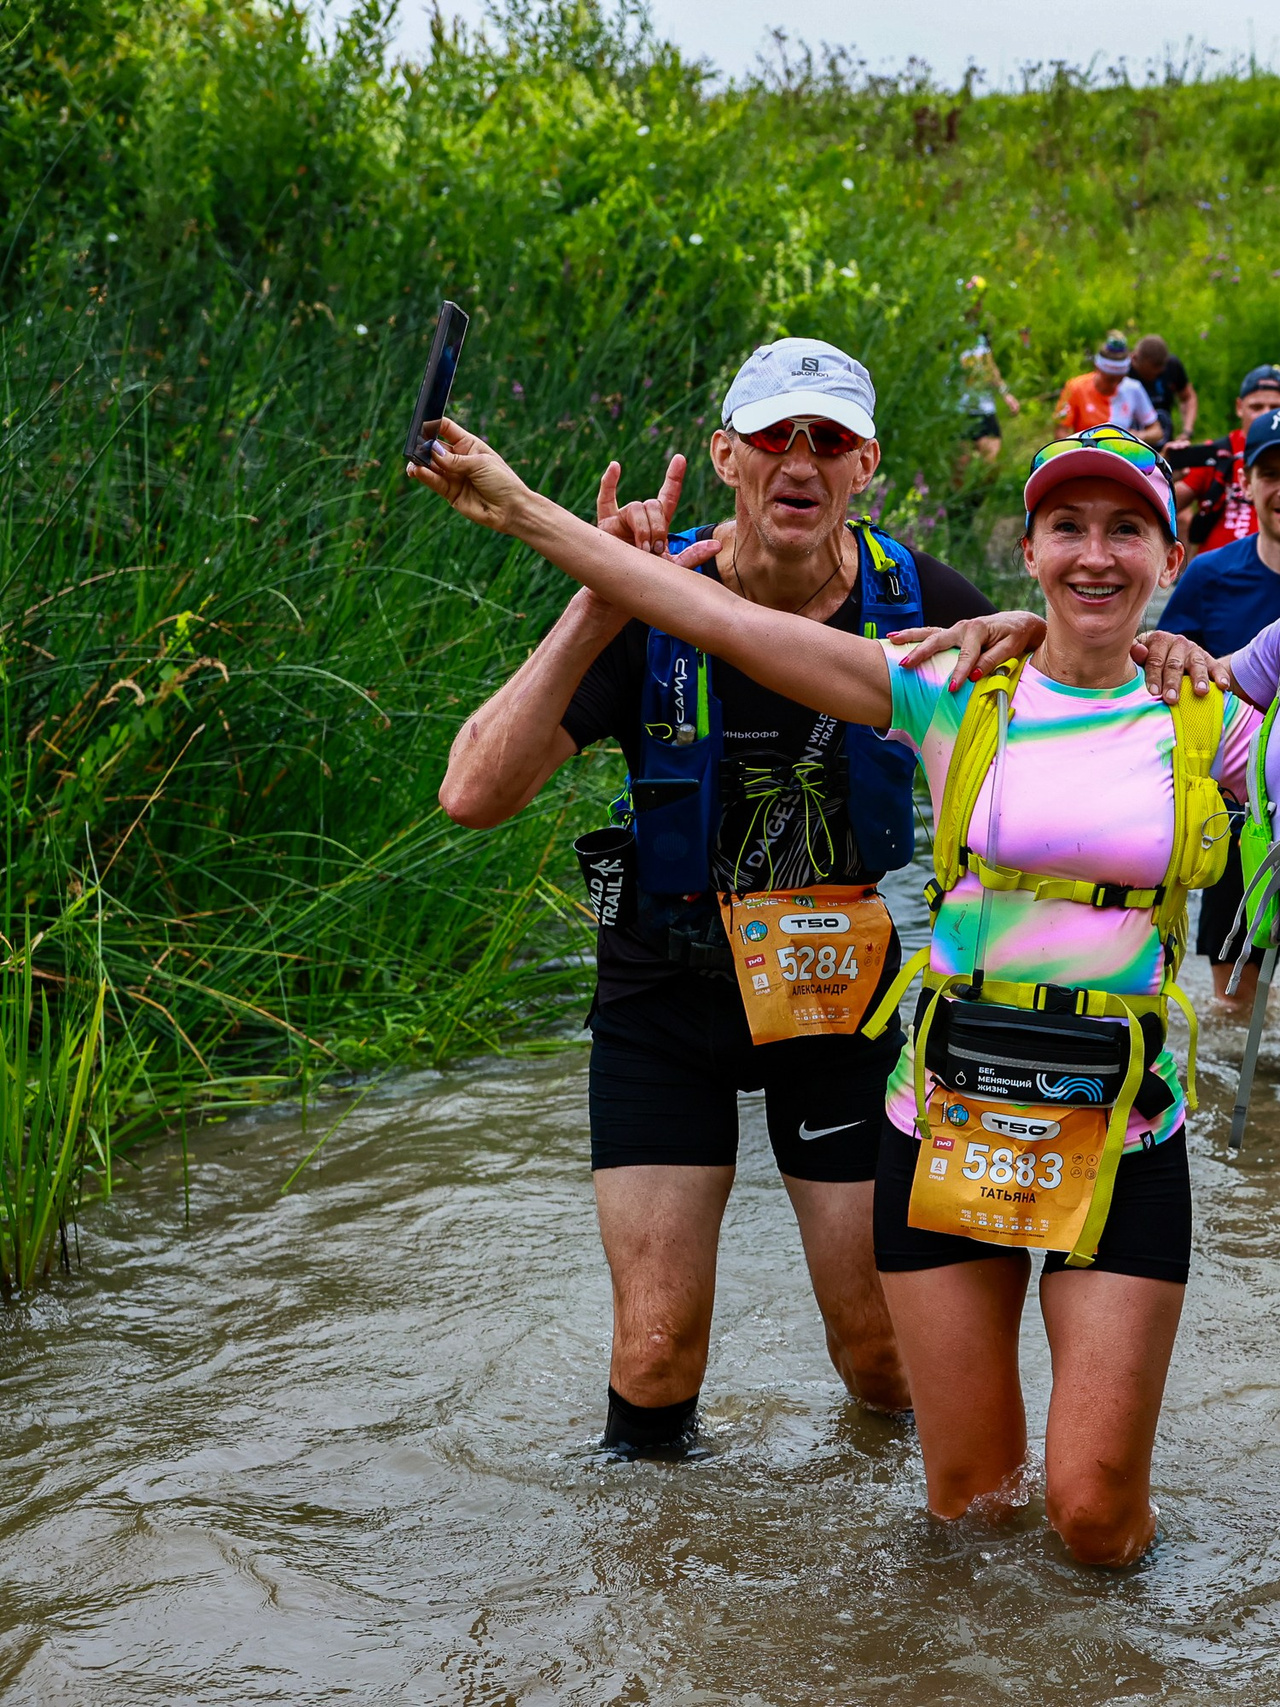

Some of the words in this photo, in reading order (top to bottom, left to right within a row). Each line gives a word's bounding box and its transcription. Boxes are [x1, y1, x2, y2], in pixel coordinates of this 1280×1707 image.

[722, 731, 780, 739] ИНЬКОФФ
[818, 718, 838, 747] TRAI
[602, 876, 623, 926] TRAIL
[791, 917, 839, 928] T50
[776, 945, 859, 981] 5284
[792, 984, 848, 996] АЛЕКСАНДР
[978, 1066, 995, 1076] БЕГ,
[978, 1075, 1032, 1088] МЕНЯЮЩИЙ
[977, 1084, 1009, 1095] ЖИЗНЬ
[992, 1116, 1048, 1136] T50
[961, 1140, 1065, 1189] 5883
[979, 1186, 1036, 1204] ТАТЬЯНА
